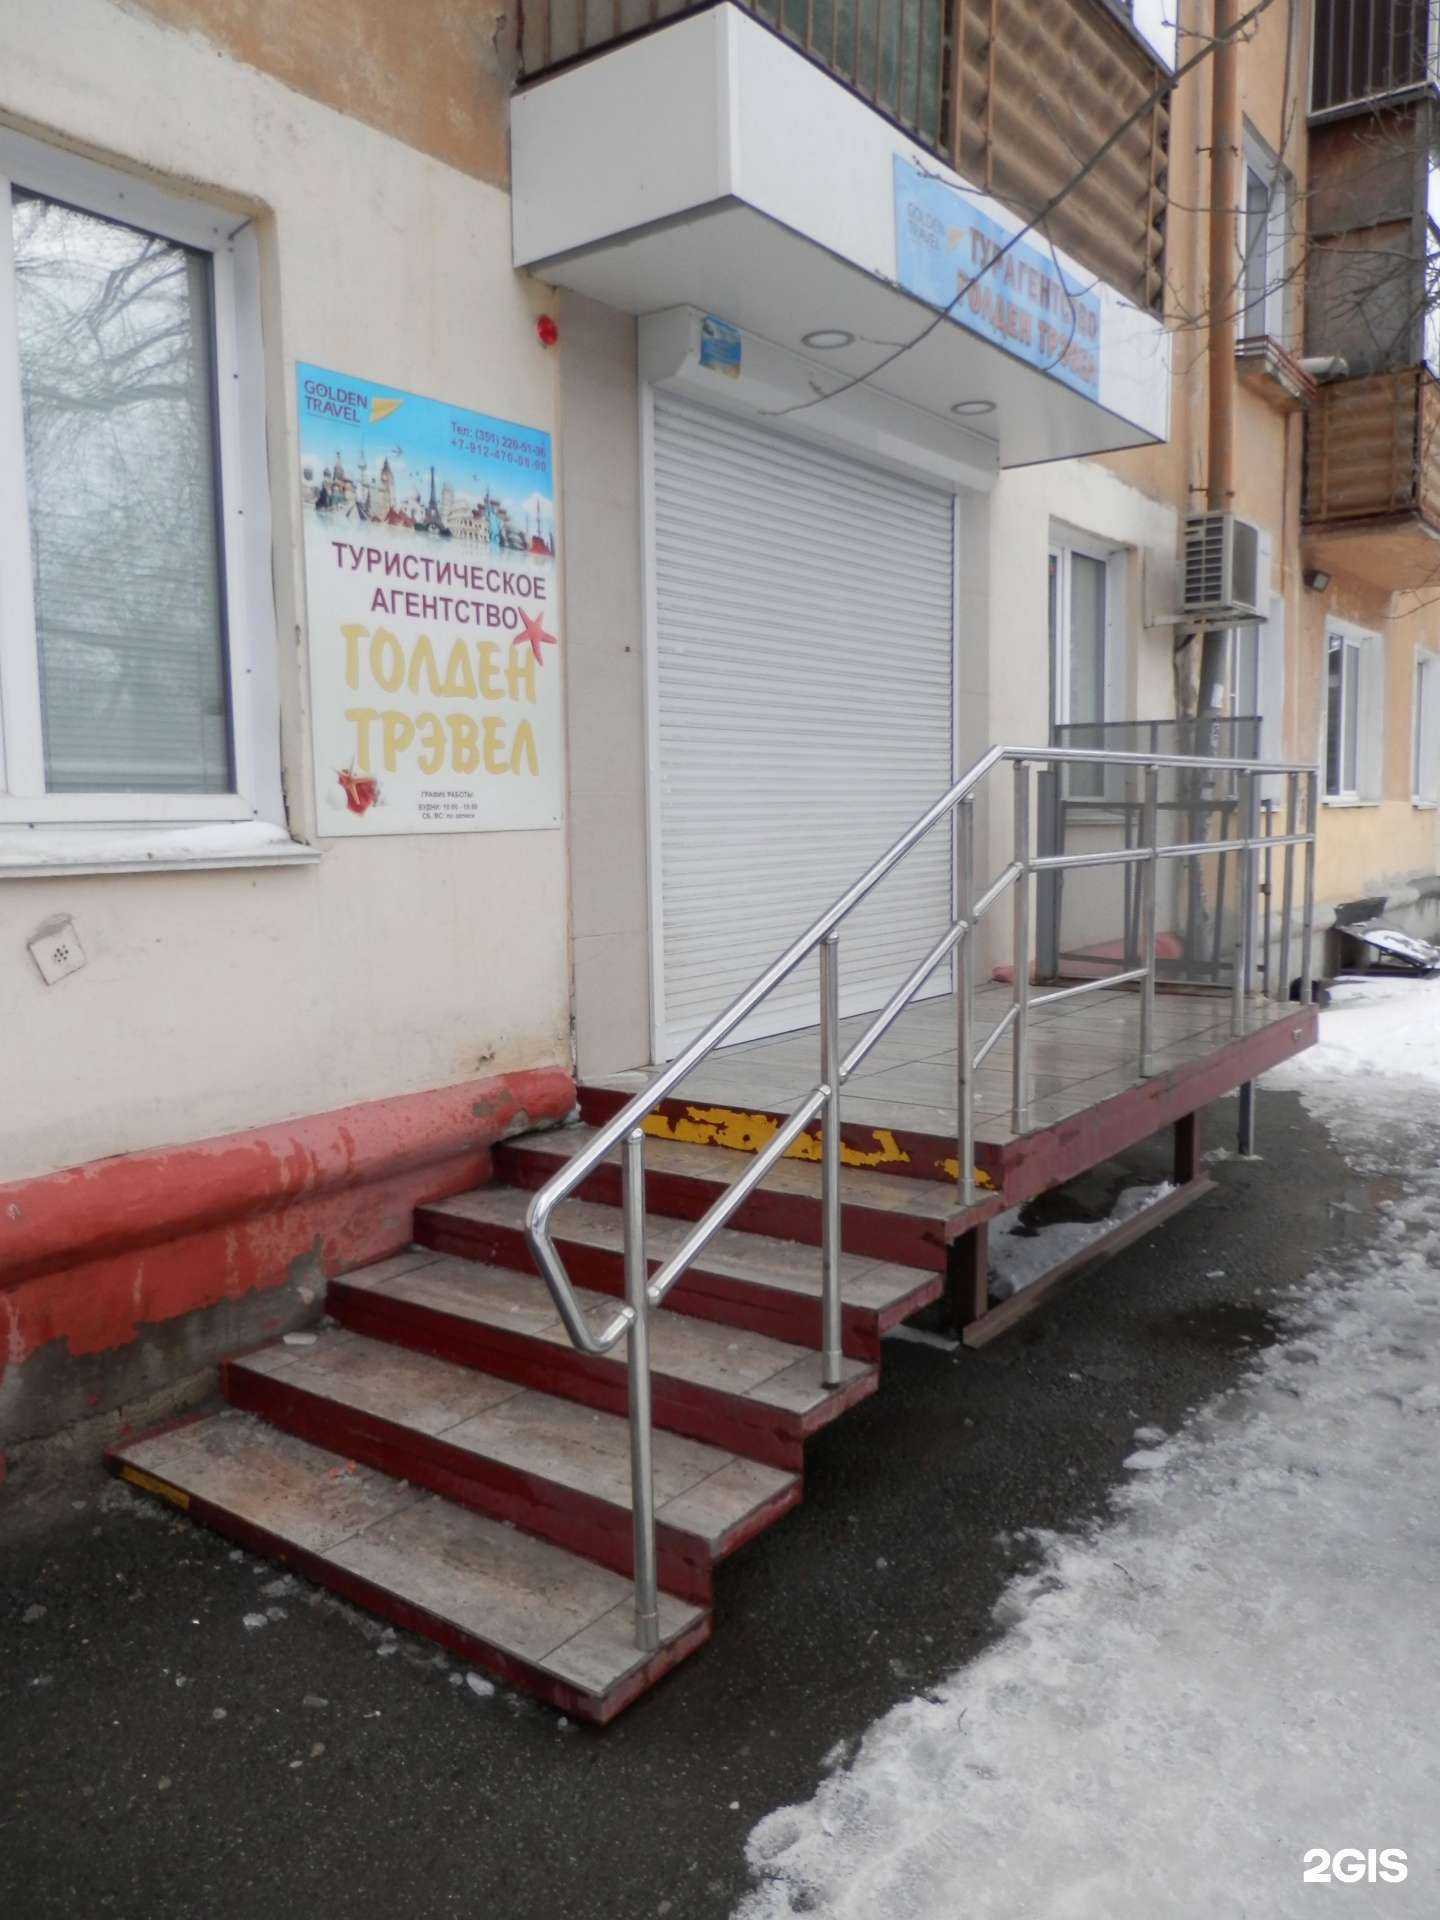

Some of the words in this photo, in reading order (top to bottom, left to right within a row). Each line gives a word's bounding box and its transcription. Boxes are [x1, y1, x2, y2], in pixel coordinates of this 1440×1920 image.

[304, 380, 368, 409] GOLDEN
[304, 396, 361, 423] TRAVEL
[331, 541, 547, 599] ТУРИСТИЧЕСКОЕ
[371, 588, 519, 630] АГЕНТСТВО
[340, 623, 537, 704] ГОЛДЕН
[344, 707, 540, 777] ТРЭВЕЛ
